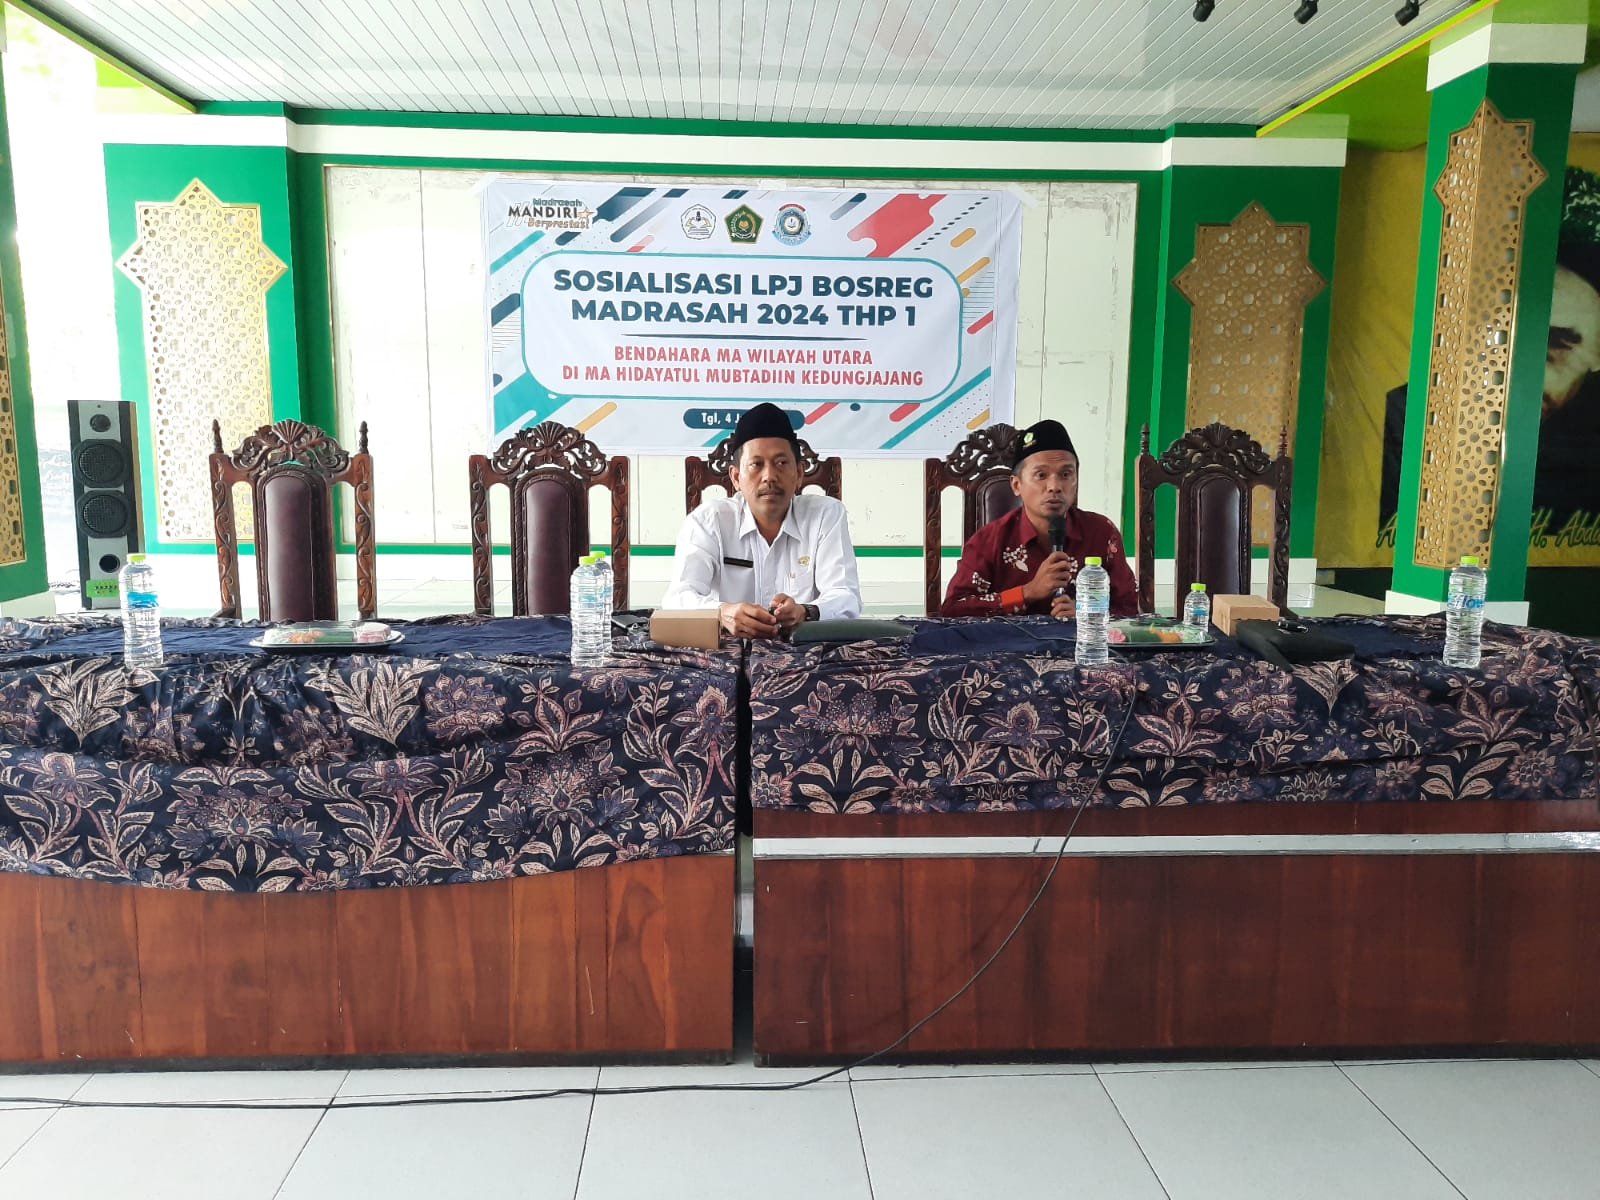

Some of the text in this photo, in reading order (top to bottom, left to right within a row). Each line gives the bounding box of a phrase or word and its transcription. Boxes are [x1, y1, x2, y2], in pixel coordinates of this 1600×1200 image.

[508, 206, 578, 218] MANDIRI
[528, 218, 589, 229] Berprestasi
[554, 269, 933, 298] SOSIALISASI LPJ BOSREG
[572, 299, 916, 326] MADRASAH 2024 THP 1
[614, 346, 873, 365] BENDAHARA MA WILAYAH UTARA
[563, 365, 923, 386] DI MA HIDAYATUL MUBTADIIN KEDUNGJAJANG
[701, 413, 721, 425] Tgl,
[725, 413, 732, 424] 4
